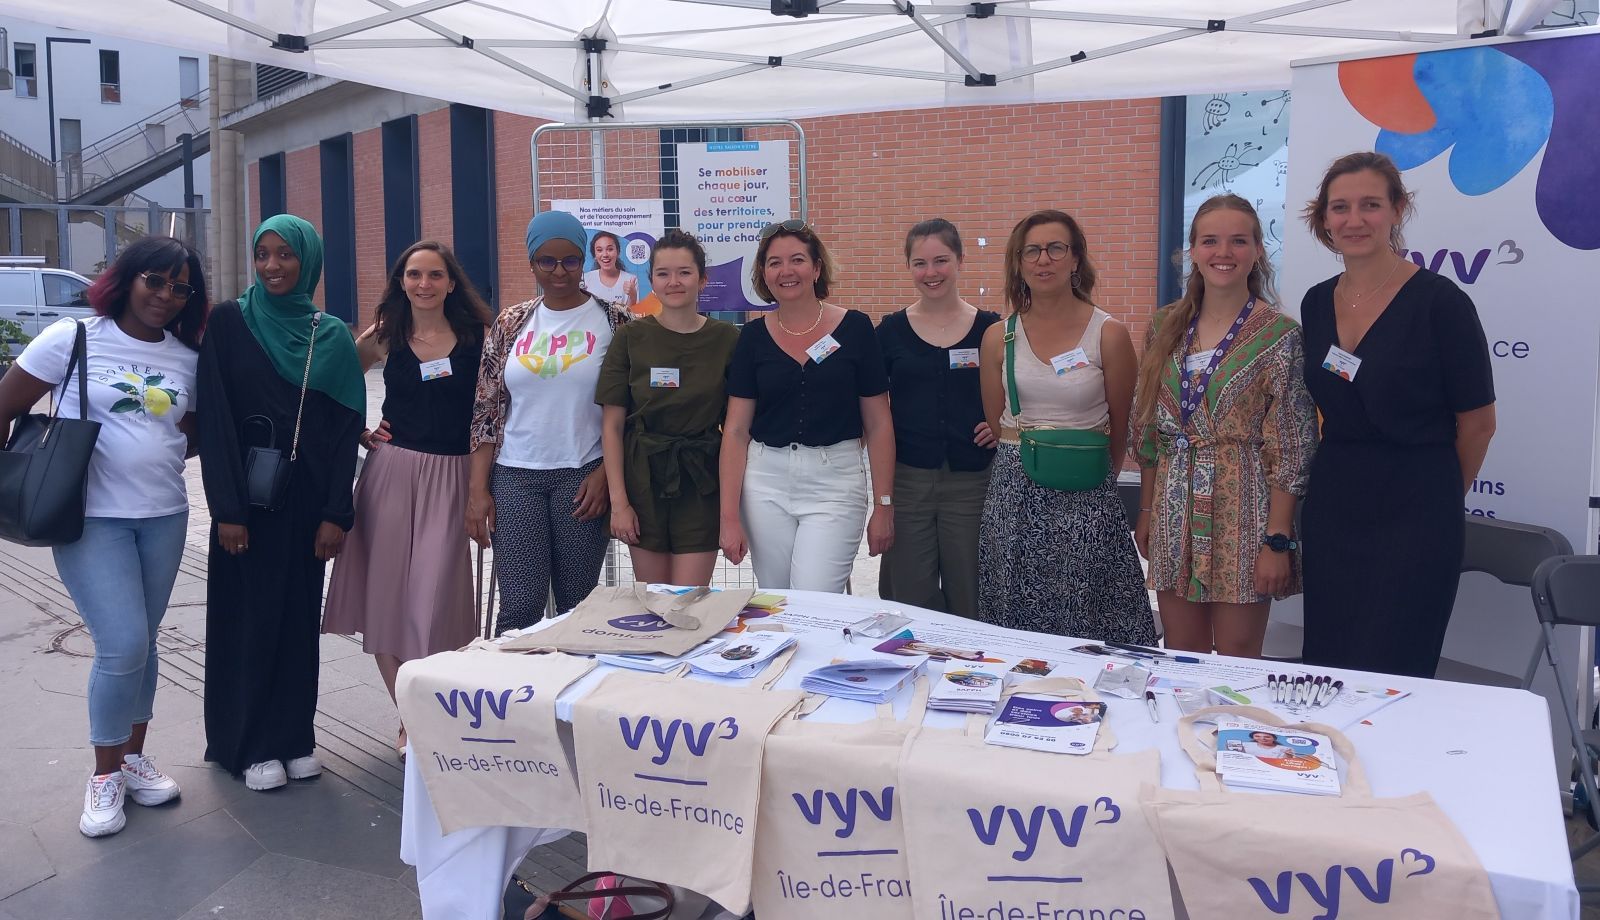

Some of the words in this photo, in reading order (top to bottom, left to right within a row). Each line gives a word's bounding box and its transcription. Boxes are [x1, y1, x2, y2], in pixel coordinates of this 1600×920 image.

[698, 167, 712, 178] Se
[715, 166, 768, 177] mobiliser
[698, 181, 741, 192] chaque
[743, 180, 769, 192] jour,
[727, 195, 758, 203] cœur
[694, 208, 714, 217] des
[716, 206, 775, 217] territoires,
[697, 222, 724, 232] pour
[727, 220, 772, 232] prendre
[696, 234, 714, 243] oin
[717, 233, 731, 242] de
[734, 233, 761, 242] chac
[516, 330, 597, 357] HAPPY
[517, 353, 589, 379] DAY
[432, 751, 559, 777] Île-de-France
[597, 783, 745, 835] Île-de-France
[791, 786, 895, 838] vyv
